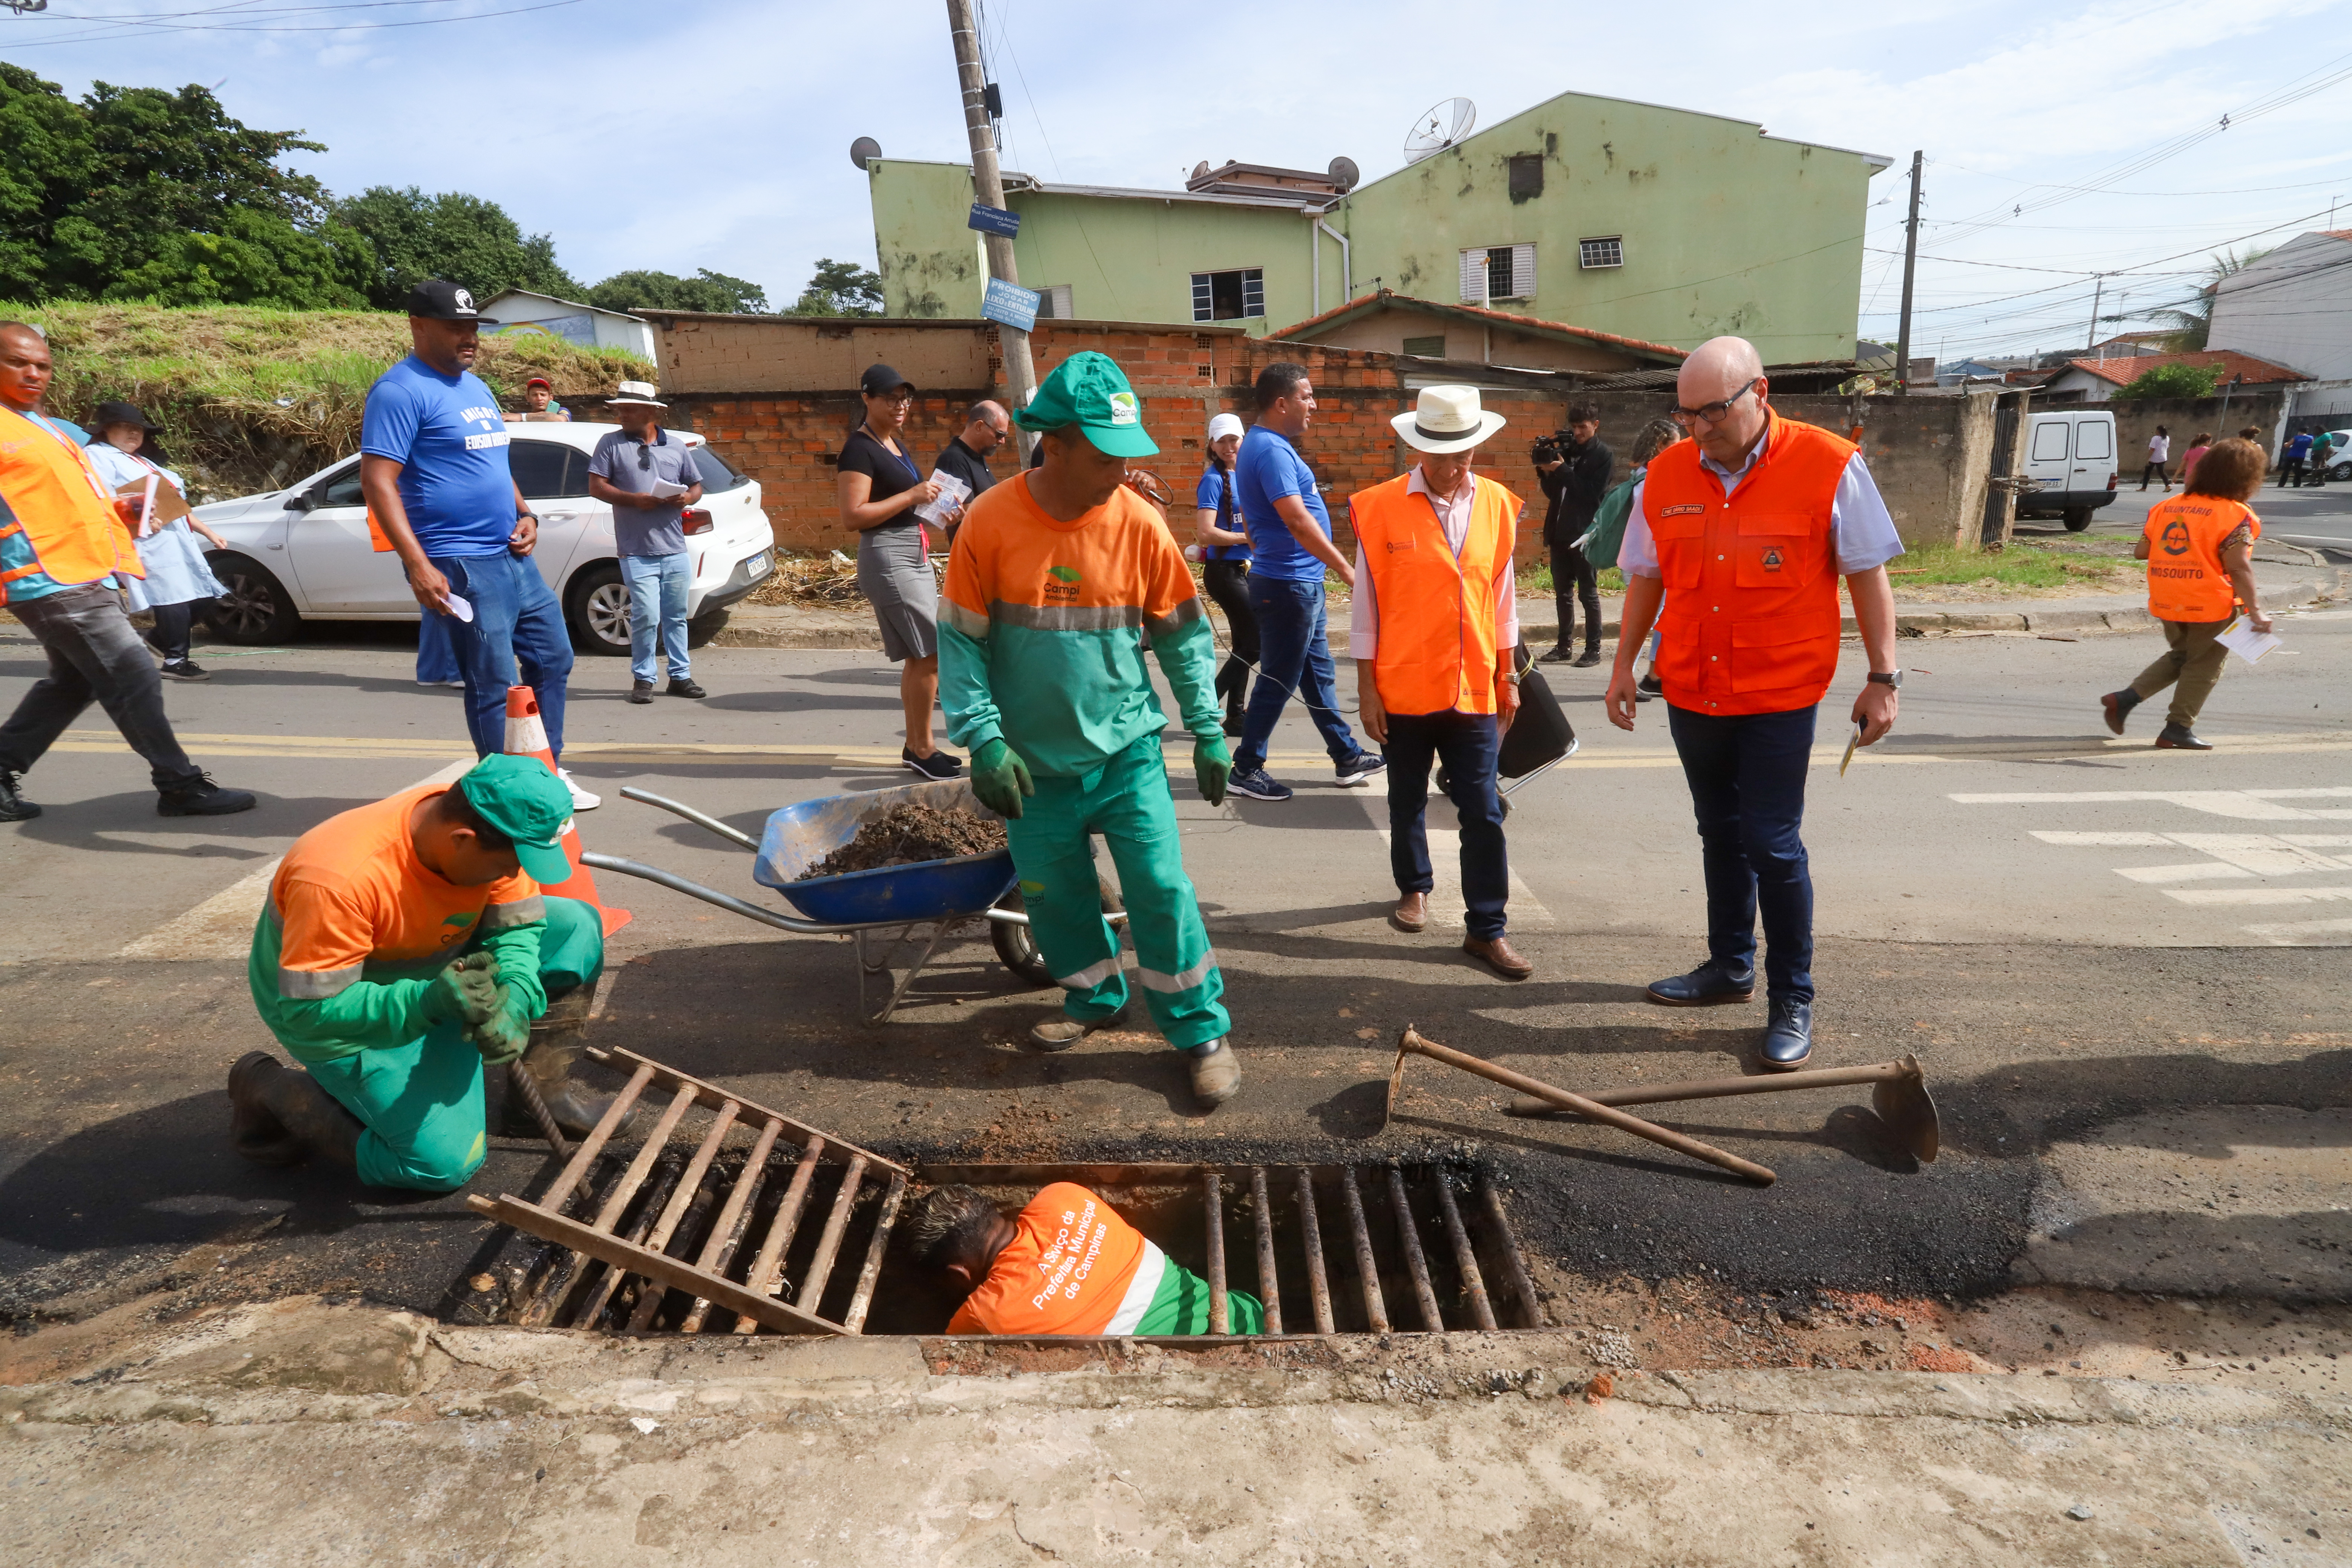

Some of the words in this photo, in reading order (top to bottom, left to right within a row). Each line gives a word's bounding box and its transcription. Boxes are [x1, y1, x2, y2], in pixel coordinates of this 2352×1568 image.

[982, 211, 1003, 221] Francisca
[997, 221, 1018, 230] Camargo
[991, 280, 1037, 301] PROIBIDO
[986, 293, 1004, 305] LIXO
[1008, 300, 1036, 316] ENTULHO
[998, 292, 1029, 305] JOGAR
[987, 306, 1008, 315] SUJEITO
[1014, 314, 1029, 323] MULTA
[460, 407, 498, 423] AMIGOS
[1113, 409, 1136, 418] Camp
[464, 433, 493, 450] EDISON
[2164, 505, 2213, 516] VOLUNTÁRIO
[2151, 567, 2203, 579] MOSQUITO
[1044, 582, 1080, 597] Campi
[1061, 1210, 1076, 1225] da
[1044, 1228, 1069, 1263] Sviço
[1032, 1256, 1077, 1310] Prefeitura
[1068, 1199, 1096, 1253] Municipal
[1064, 1282, 1080, 1299] de
[1075, 1222, 1107, 1280] Campinas
[1038, 1263, 1052, 1276] A
